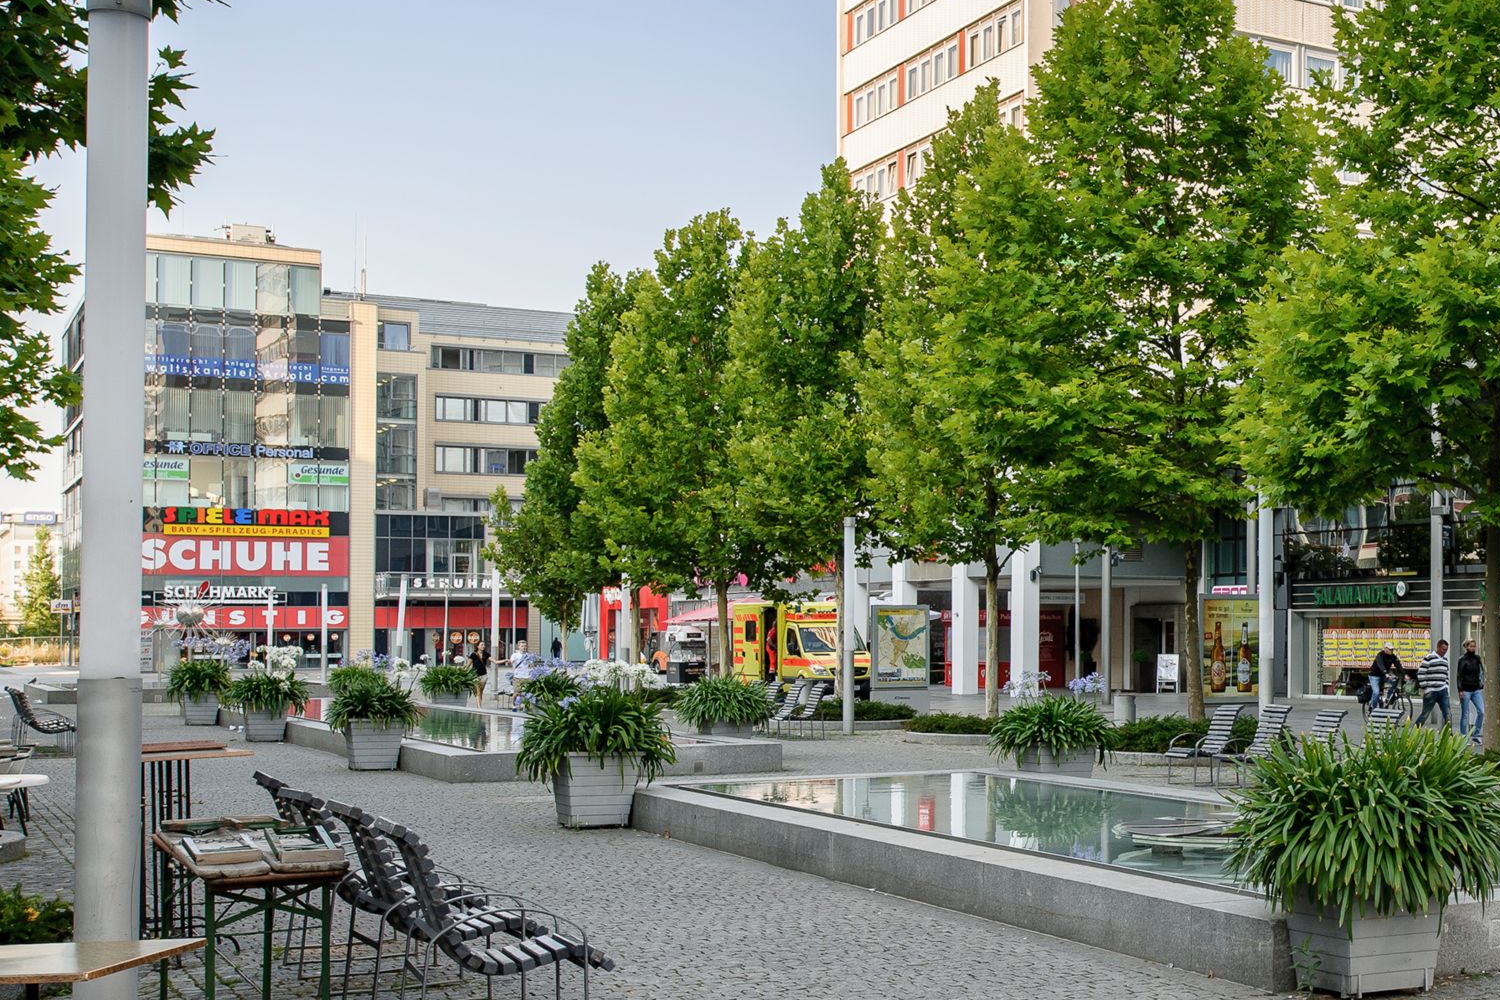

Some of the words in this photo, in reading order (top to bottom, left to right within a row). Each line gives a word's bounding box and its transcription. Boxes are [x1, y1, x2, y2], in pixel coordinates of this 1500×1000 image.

[190, 443, 250, 457] OFFICE
[255, 444, 314, 459] Personal
[143, 460, 184, 470] esunde
[301, 465, 345, 475] Gesunde
[164, 506, 252, 524] SPIELE
[209, 526, 323, 536] SPIELZEUG-PARADIES
[142, 539, 330, 571] SCHUHE
[1313, 584, 1397, 606] SALAMANDER
